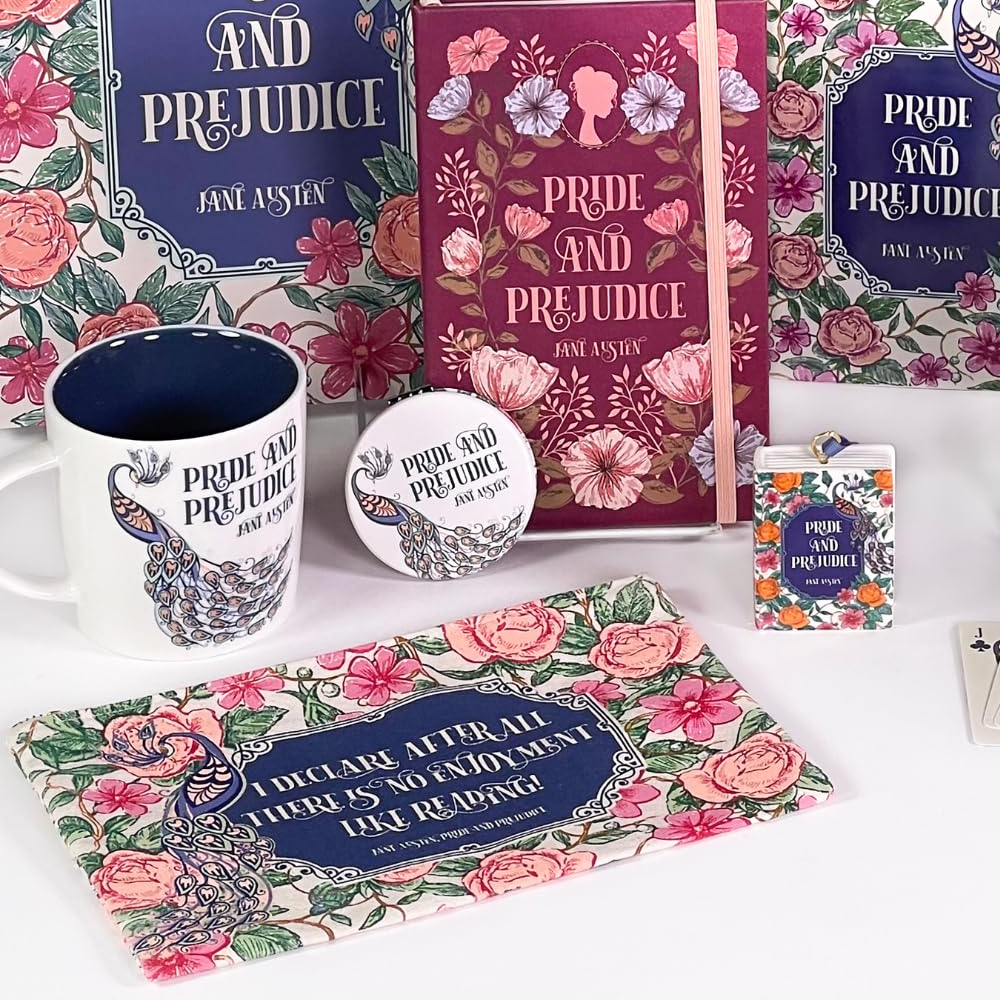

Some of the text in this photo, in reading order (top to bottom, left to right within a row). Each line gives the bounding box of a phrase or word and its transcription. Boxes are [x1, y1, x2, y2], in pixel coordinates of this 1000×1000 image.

[206, 3, 311, 72] AND
[140, 77, 386, 152] PREJUDICE
[884, 93, 973, 134] PRIDE
[892, 136, 959, 176] AND
[196, 176, 335, 217] JANE AUSTEN
[542, 174, 645, 221] PRIDE
[554, 223, 632, 273] AND
[505, 282, 687, 333] PREJUDICE
[552, 336, 647, 363] JANE AUSTEN
[182, 418, 297, 493] PRIDE AND
[400, 422, 497, 478] PRIDE AND
[183, 454, 297, 526] PREJUDICE
[408, 450, 508, 502] PREJUDICE
[454, 475, 510, 507] JANE AUSTEN
[237, 512, 263, 537] JANE
[805, 520, 843, 536] PRIDE
[809, 536, 839, 552] AND
[791, 554, 858, 571] PREJUDICE
[974, 627, 983, 638] J
[241, 723, 593, 827] THERE IS NO ENJOYMENT
[251, 710, 552, 797] I DECLARE AFTER ALL
[339, 774, 545, 837] LIKE READING!
